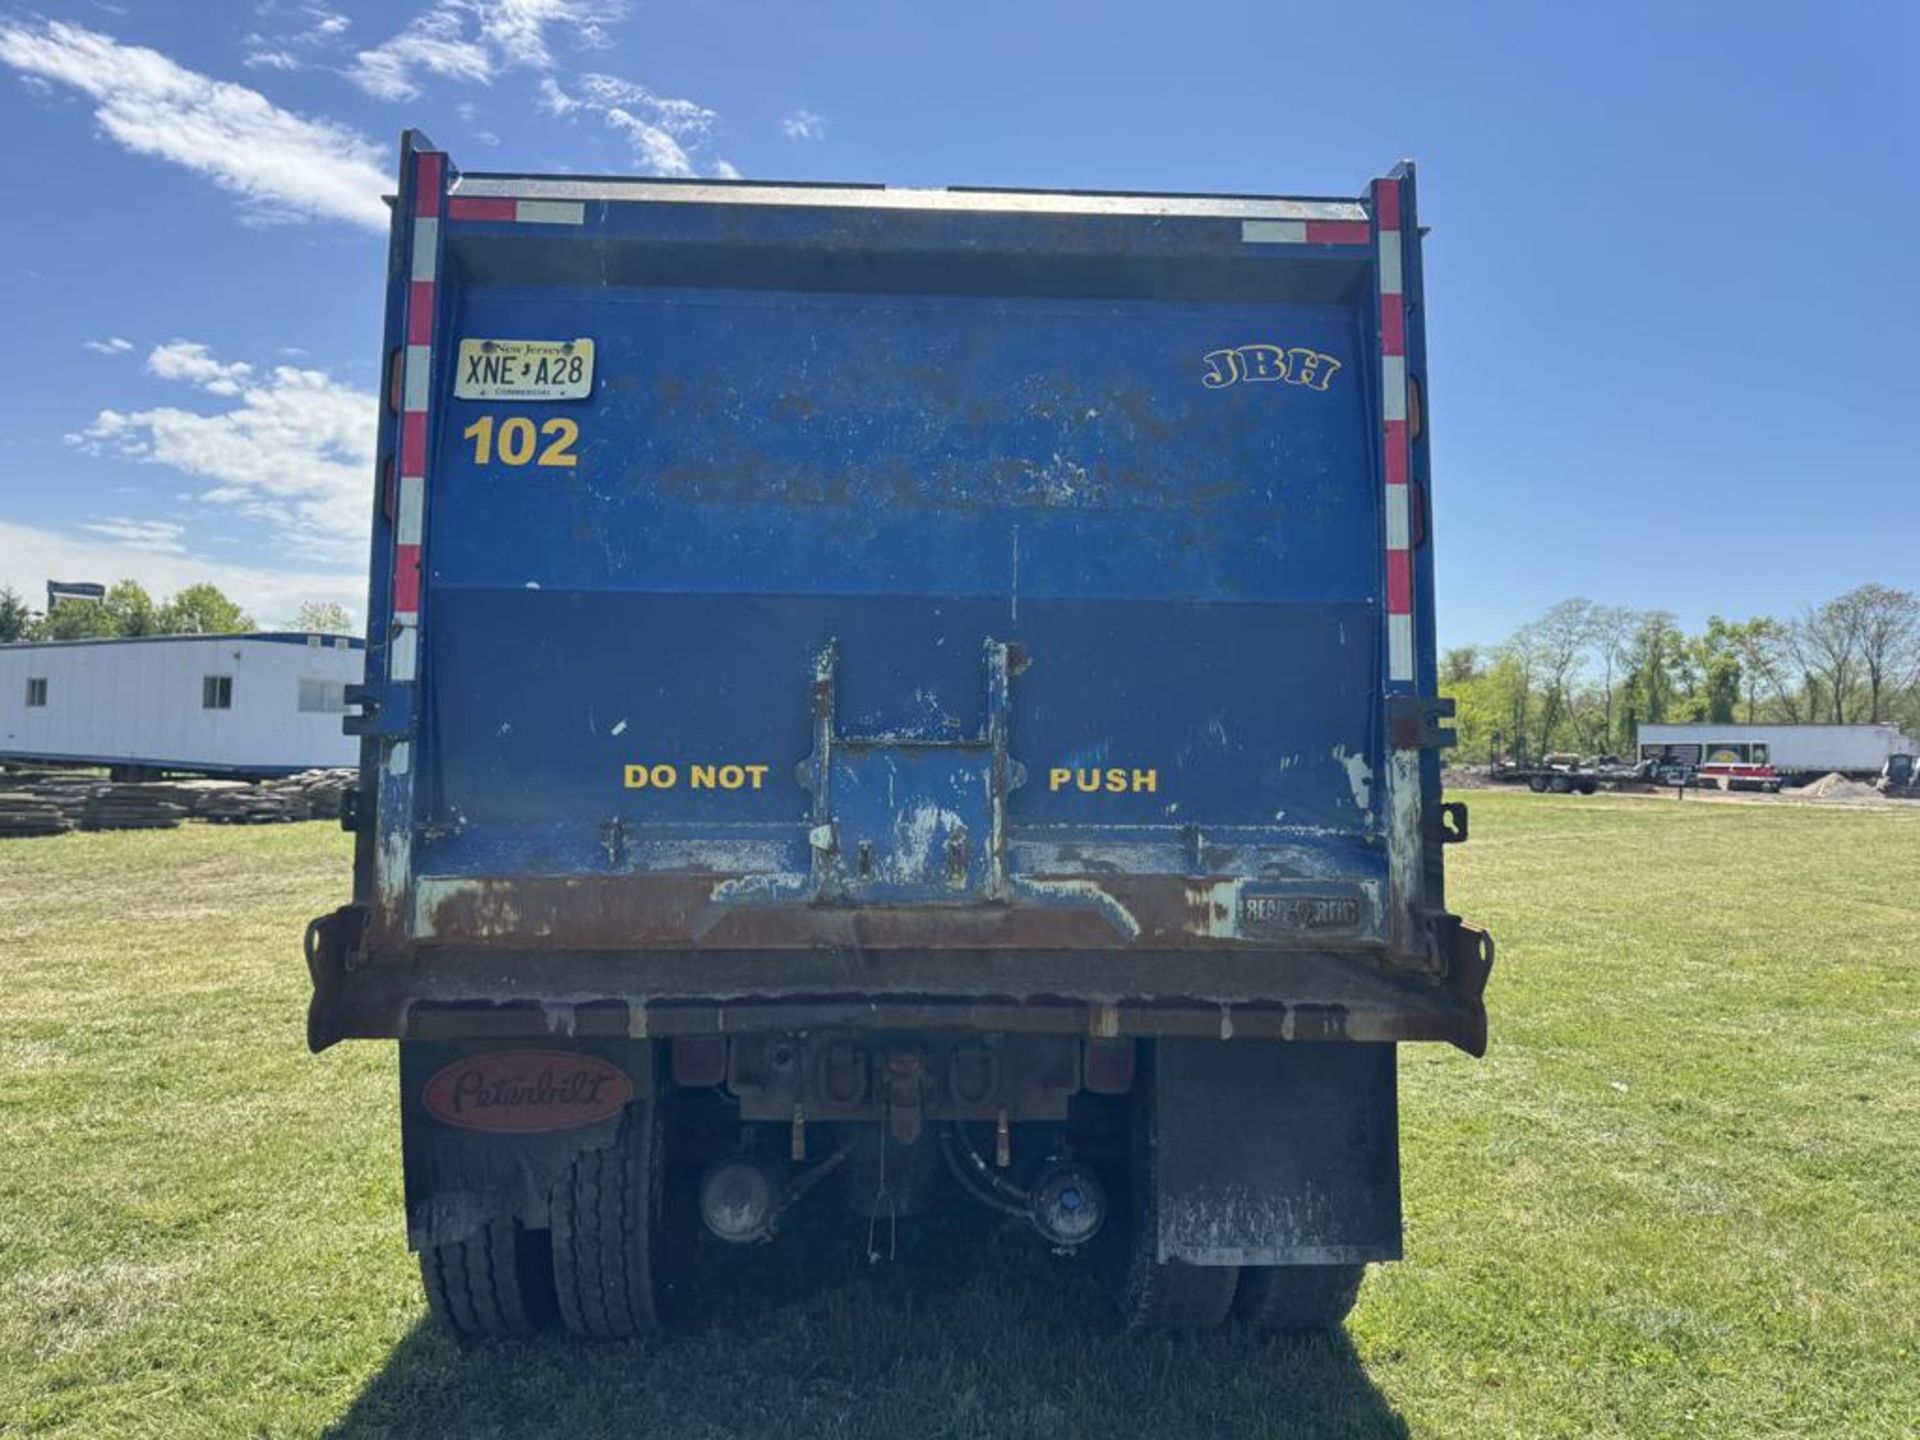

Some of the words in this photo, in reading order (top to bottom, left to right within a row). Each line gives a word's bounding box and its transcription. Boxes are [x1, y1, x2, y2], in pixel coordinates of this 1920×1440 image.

[496, 344, 521, 354] New
[523, 344, 561, 356] Jersey
[466, 355, 517, 385] XNE
[534, 356, 583, 385] A28
[1202, 344, 1342, 390] JBH
[464, 416, 579, 466] 102
[624, 764, 677, 789] DO
[691, 765, 769, 789] NOT
[1049, 768, 1157, 792] PUSH
[453, 1070, 615, 1114] Peterbilt
